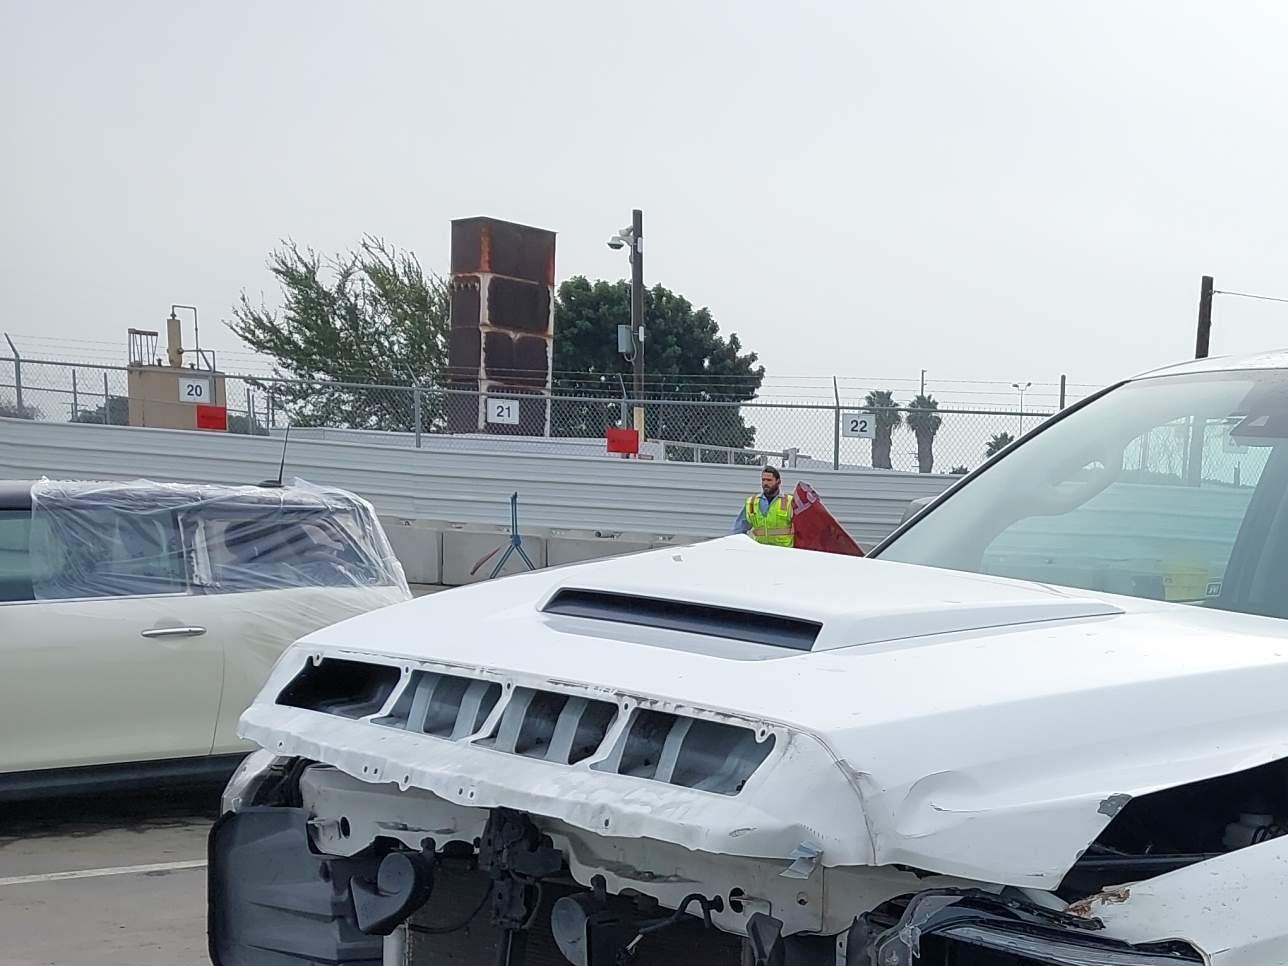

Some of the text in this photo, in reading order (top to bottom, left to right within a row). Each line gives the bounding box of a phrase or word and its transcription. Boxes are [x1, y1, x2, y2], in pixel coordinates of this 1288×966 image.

[187, 384, 203, 397] 20
[496, 405, 511, 418] 21
[850, 419, 868, 433] 22
